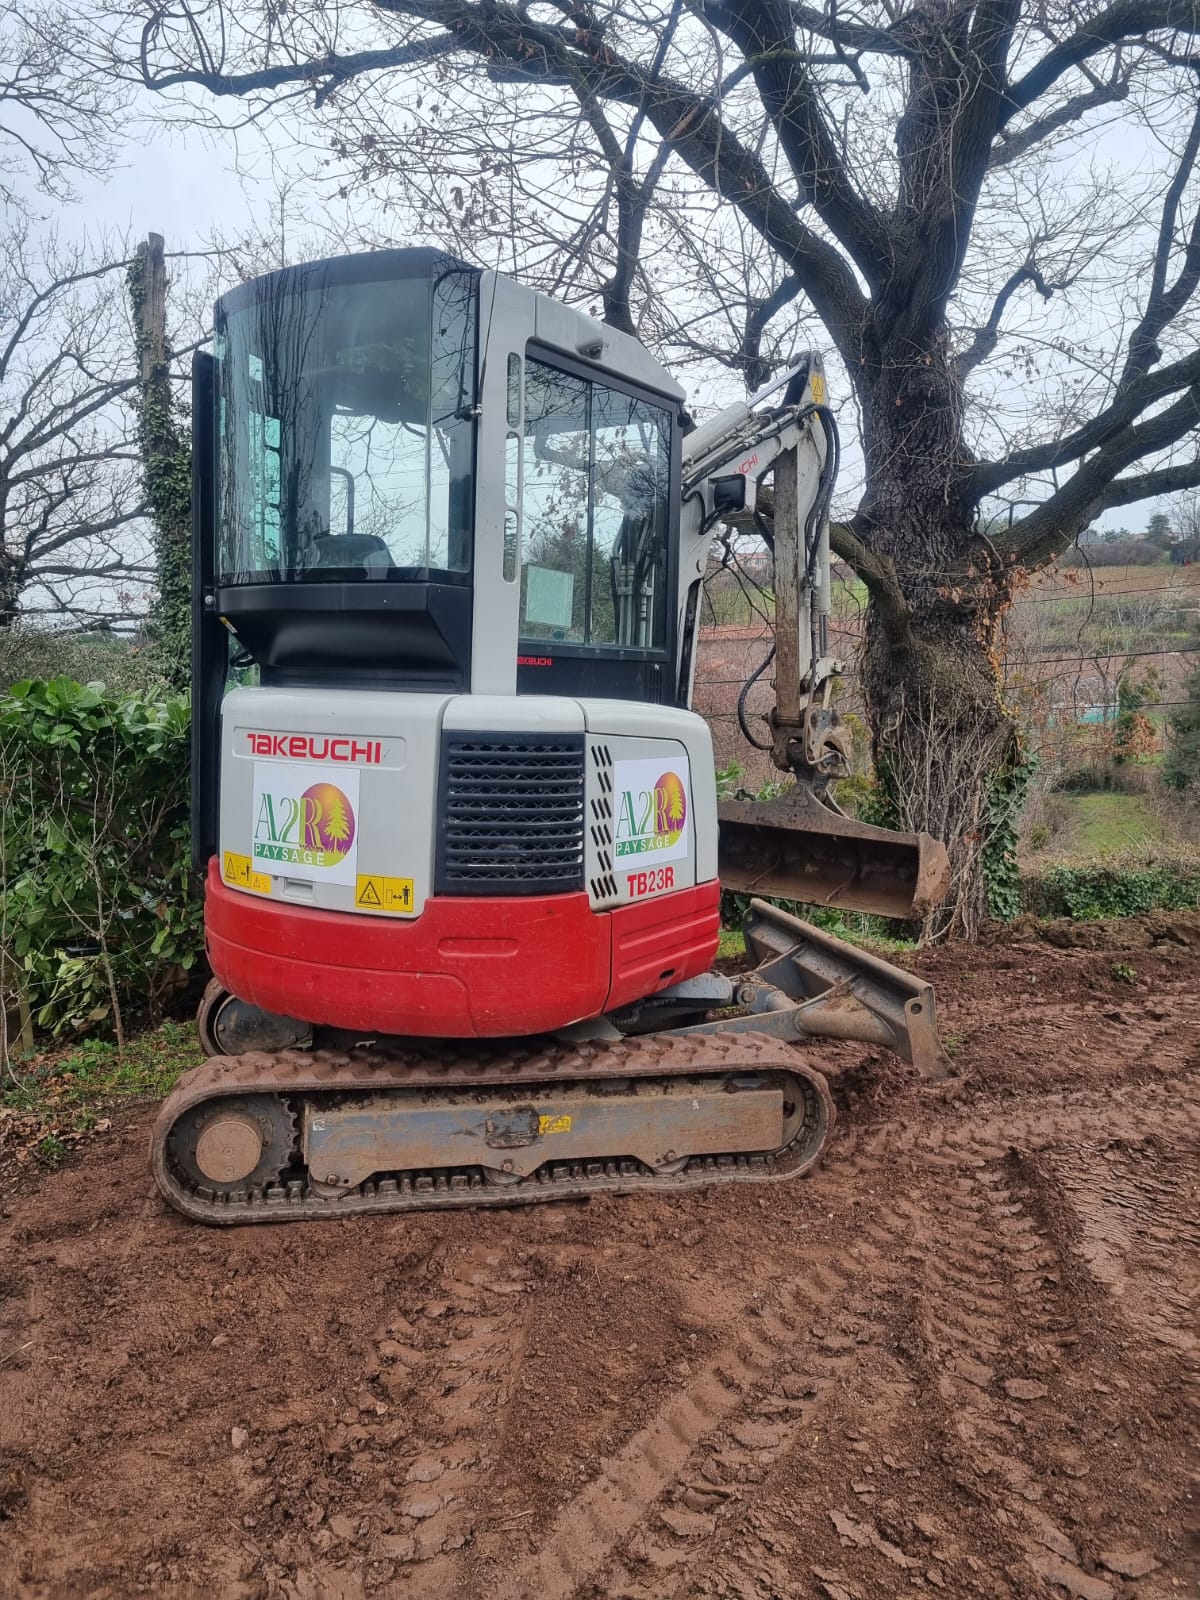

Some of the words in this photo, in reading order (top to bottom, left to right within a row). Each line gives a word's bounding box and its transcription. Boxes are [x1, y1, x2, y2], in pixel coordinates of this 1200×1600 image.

[247, 733, 381, 763] TAKEUCHI
[254, 844, 326, 866] PAYSAGE
[616, 836, 670, 855] PAYSAGE
[627, 866, 674, 897] TB23R
